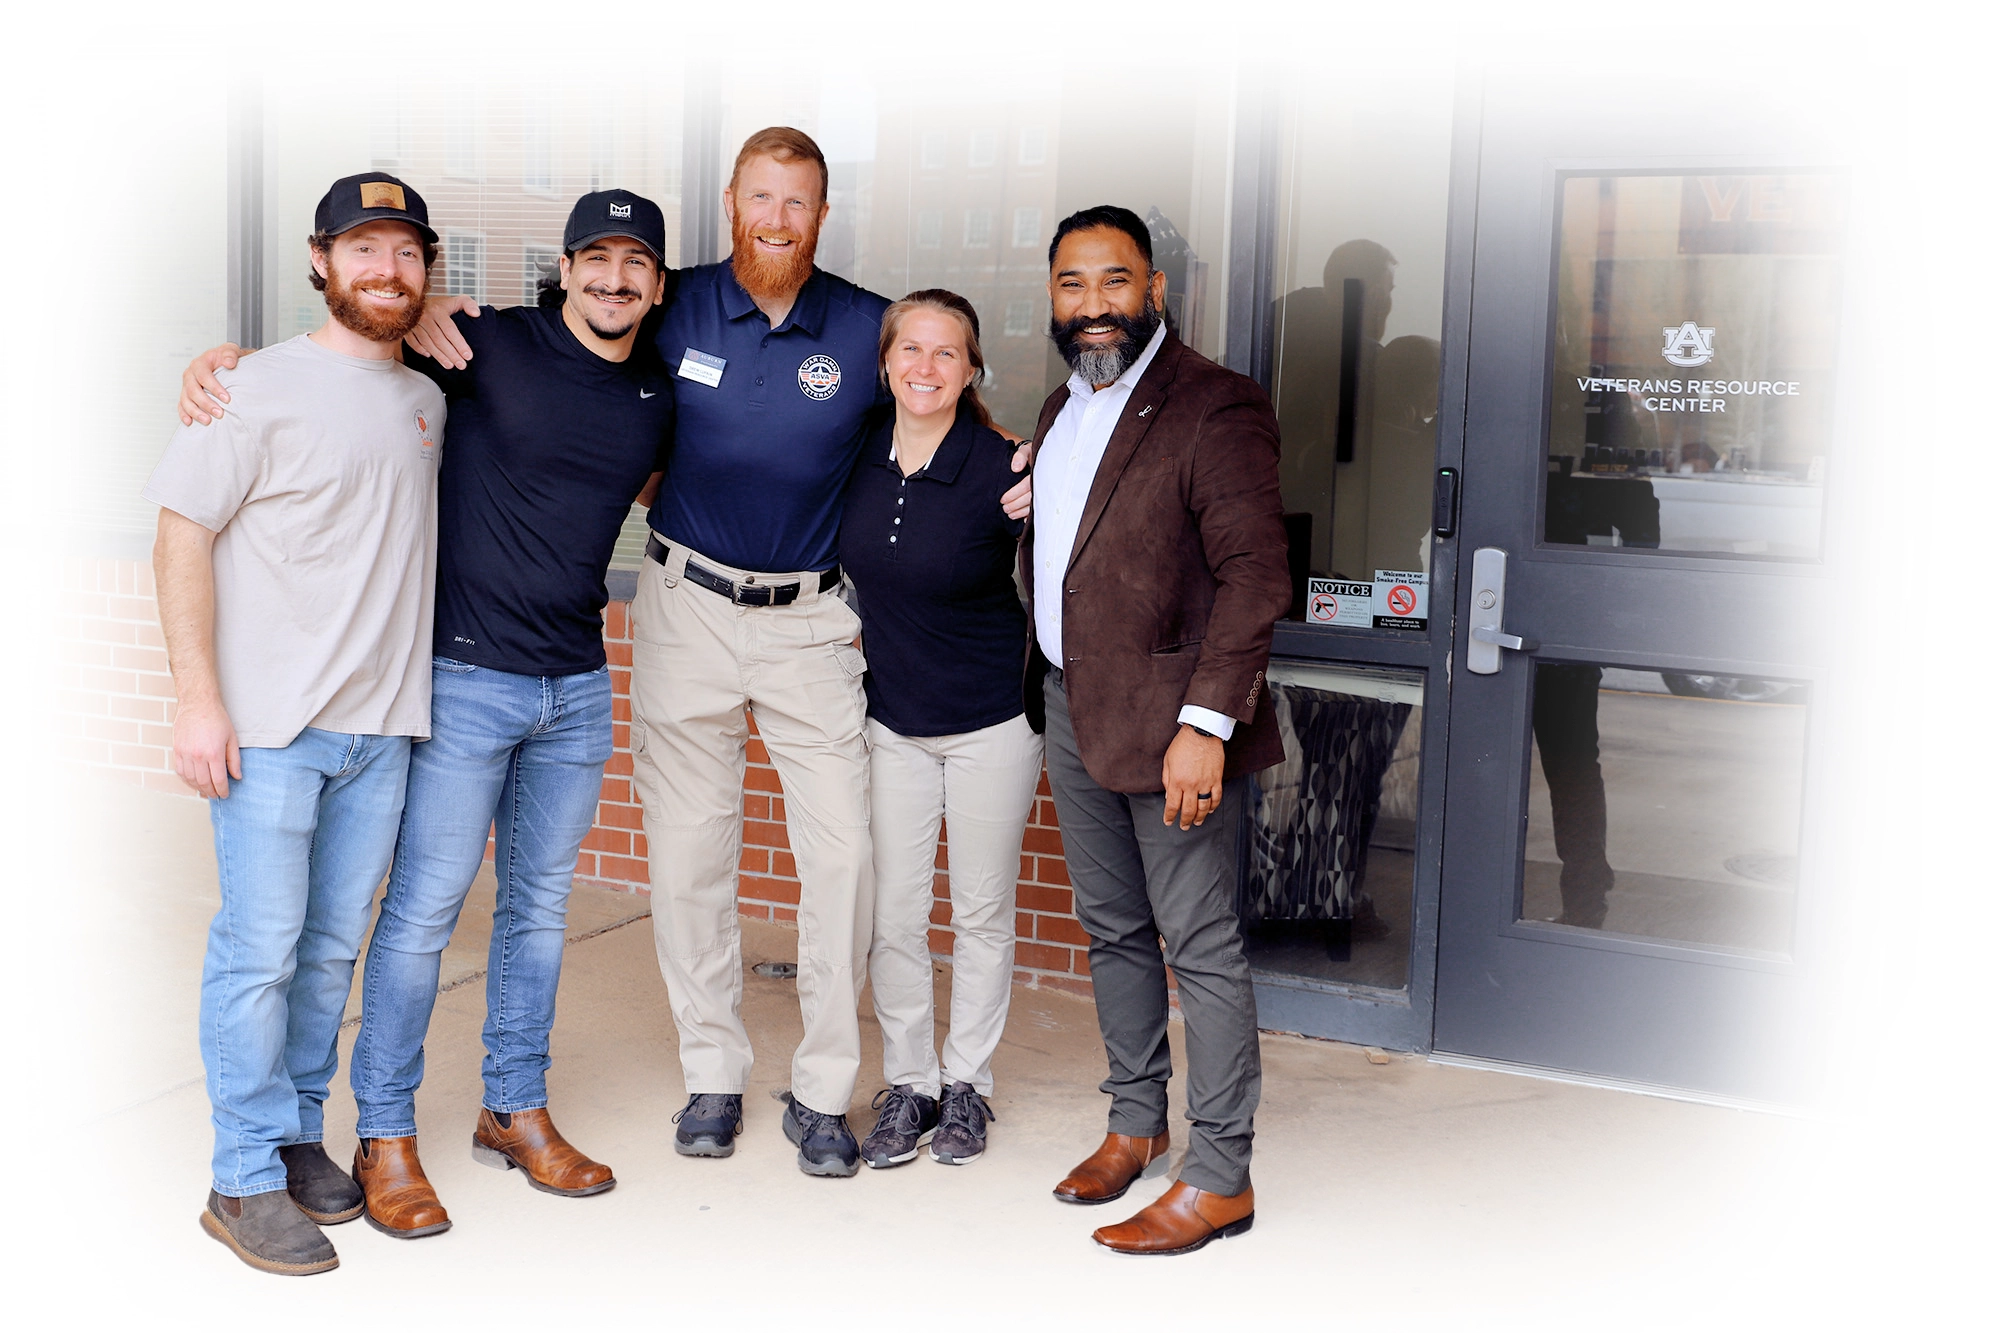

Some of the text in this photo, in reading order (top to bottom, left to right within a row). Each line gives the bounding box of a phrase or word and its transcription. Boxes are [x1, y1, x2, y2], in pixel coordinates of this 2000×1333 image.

[803, 357, 837, 372] WAR DAMN
[802, 382, 837, 398] VETERANS
[1577, 377, 1801, 396] VETERANS RESOURCE
[1645, 397, 1726, 413] CENTER
[1313, 582, 1370, 596] NOTICE
